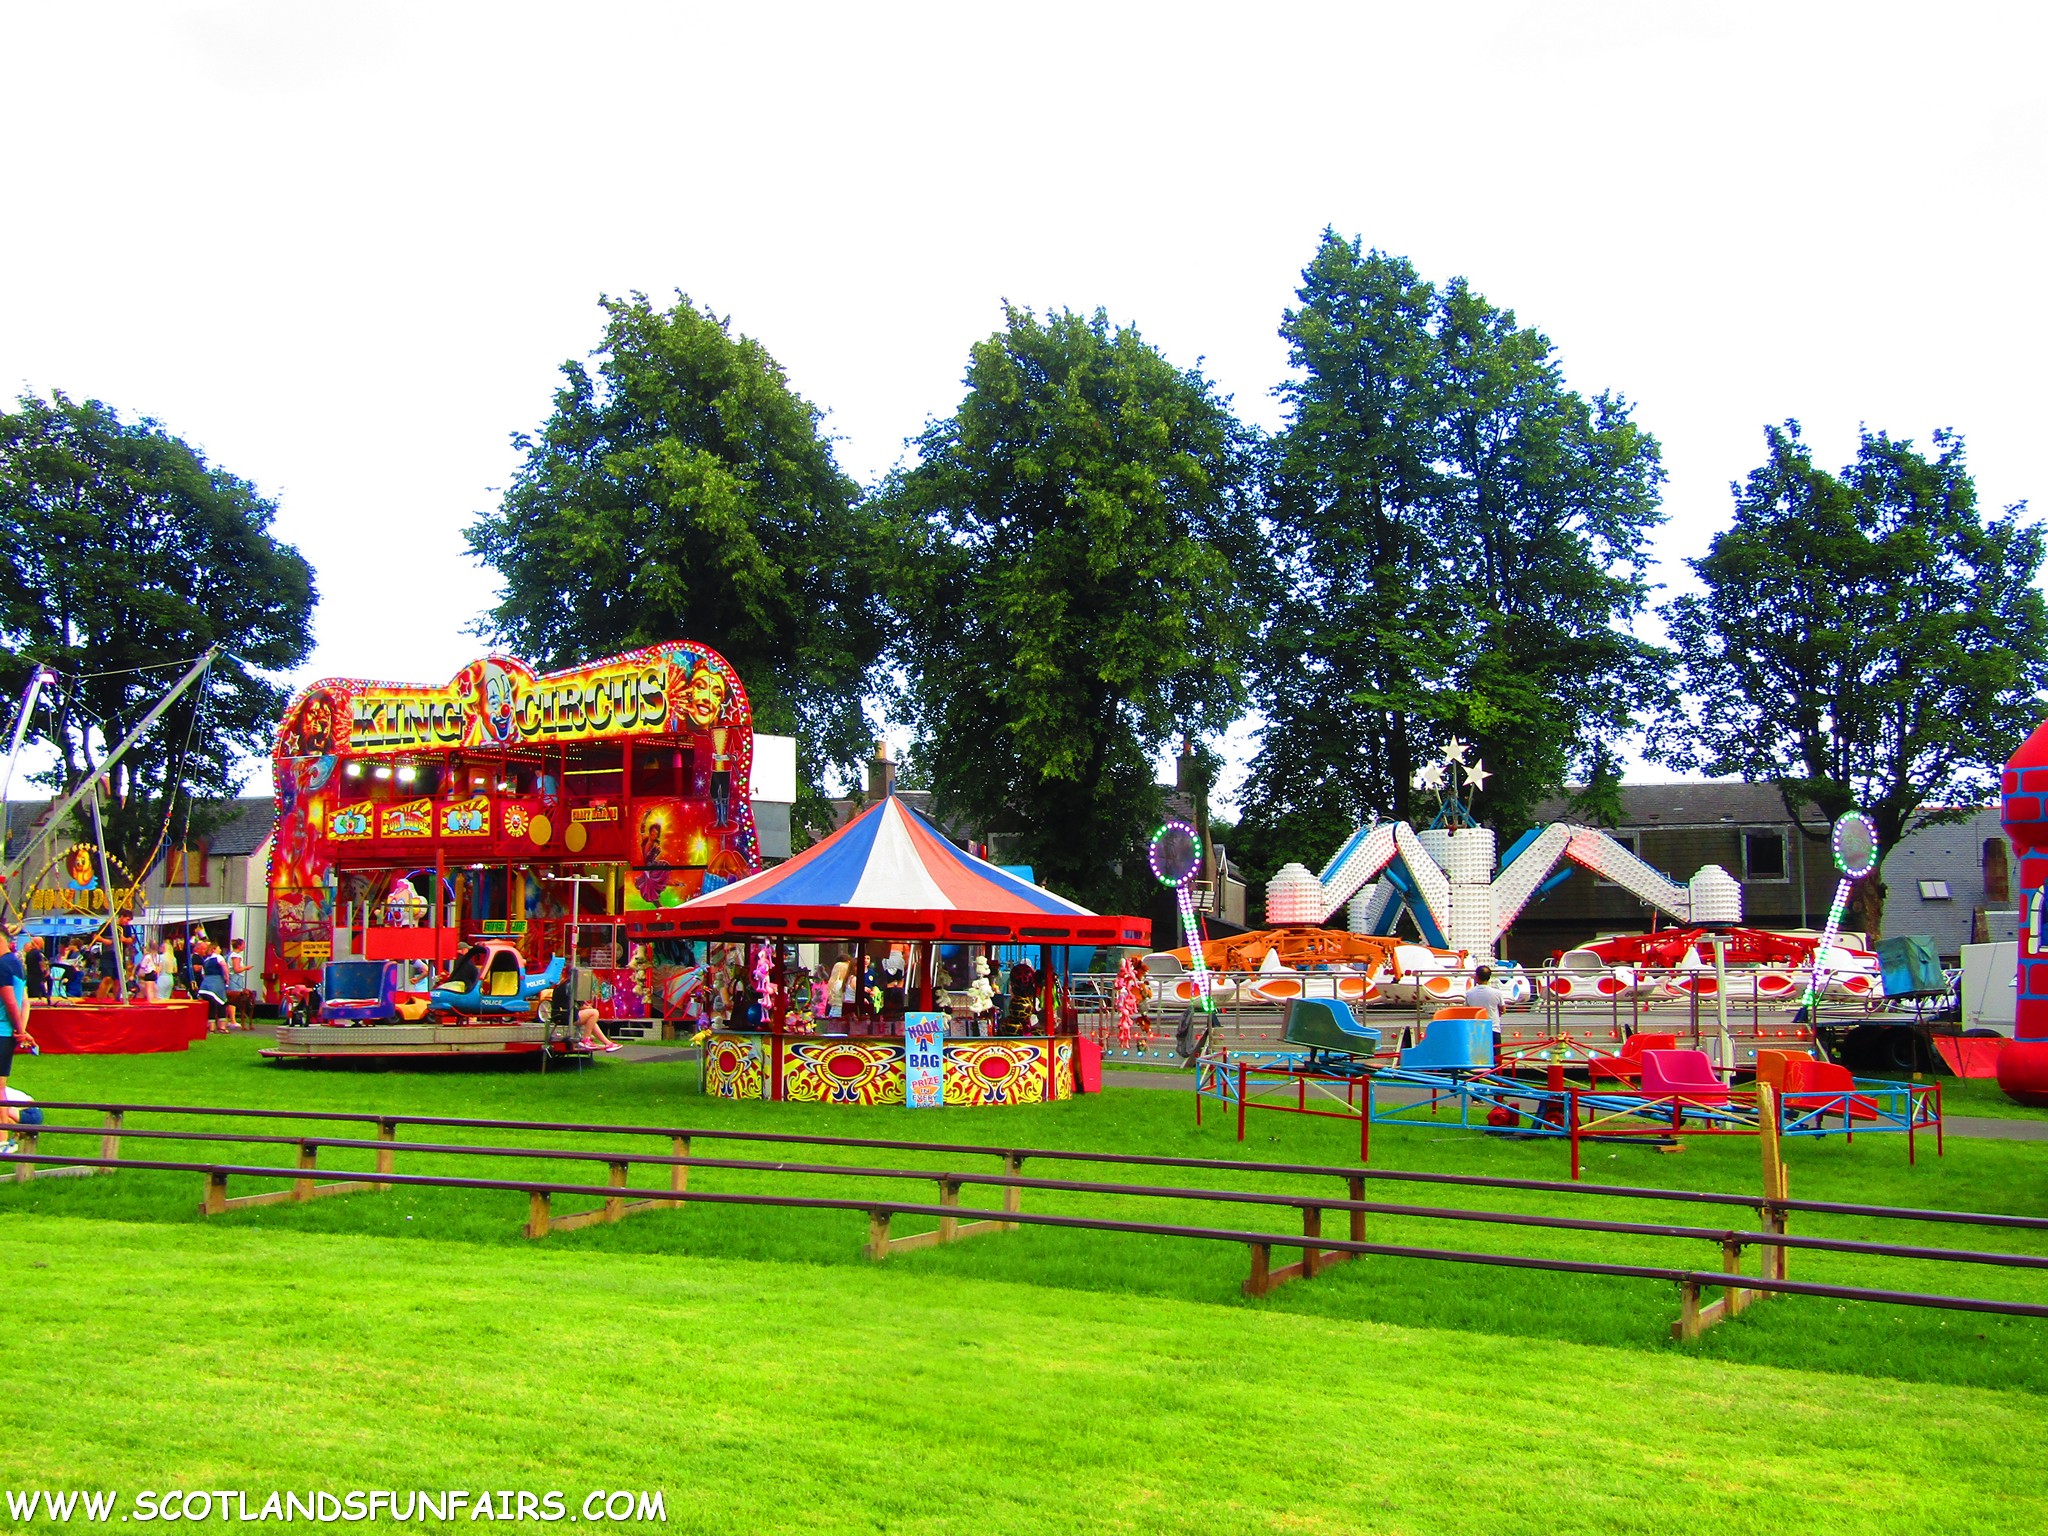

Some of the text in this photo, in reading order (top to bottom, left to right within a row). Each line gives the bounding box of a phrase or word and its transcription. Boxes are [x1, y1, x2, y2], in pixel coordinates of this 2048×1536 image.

[351, 668, 668, 747] KING CIRCUS
[526, 979, 546, 988] POLICE
[907, 1020, 941, 1039] HOOK
[919, 1038, 928, 1052] A
[909, 1054, 940, 1067] BAG
[911, 1075, 940, 1088] PRIZE
